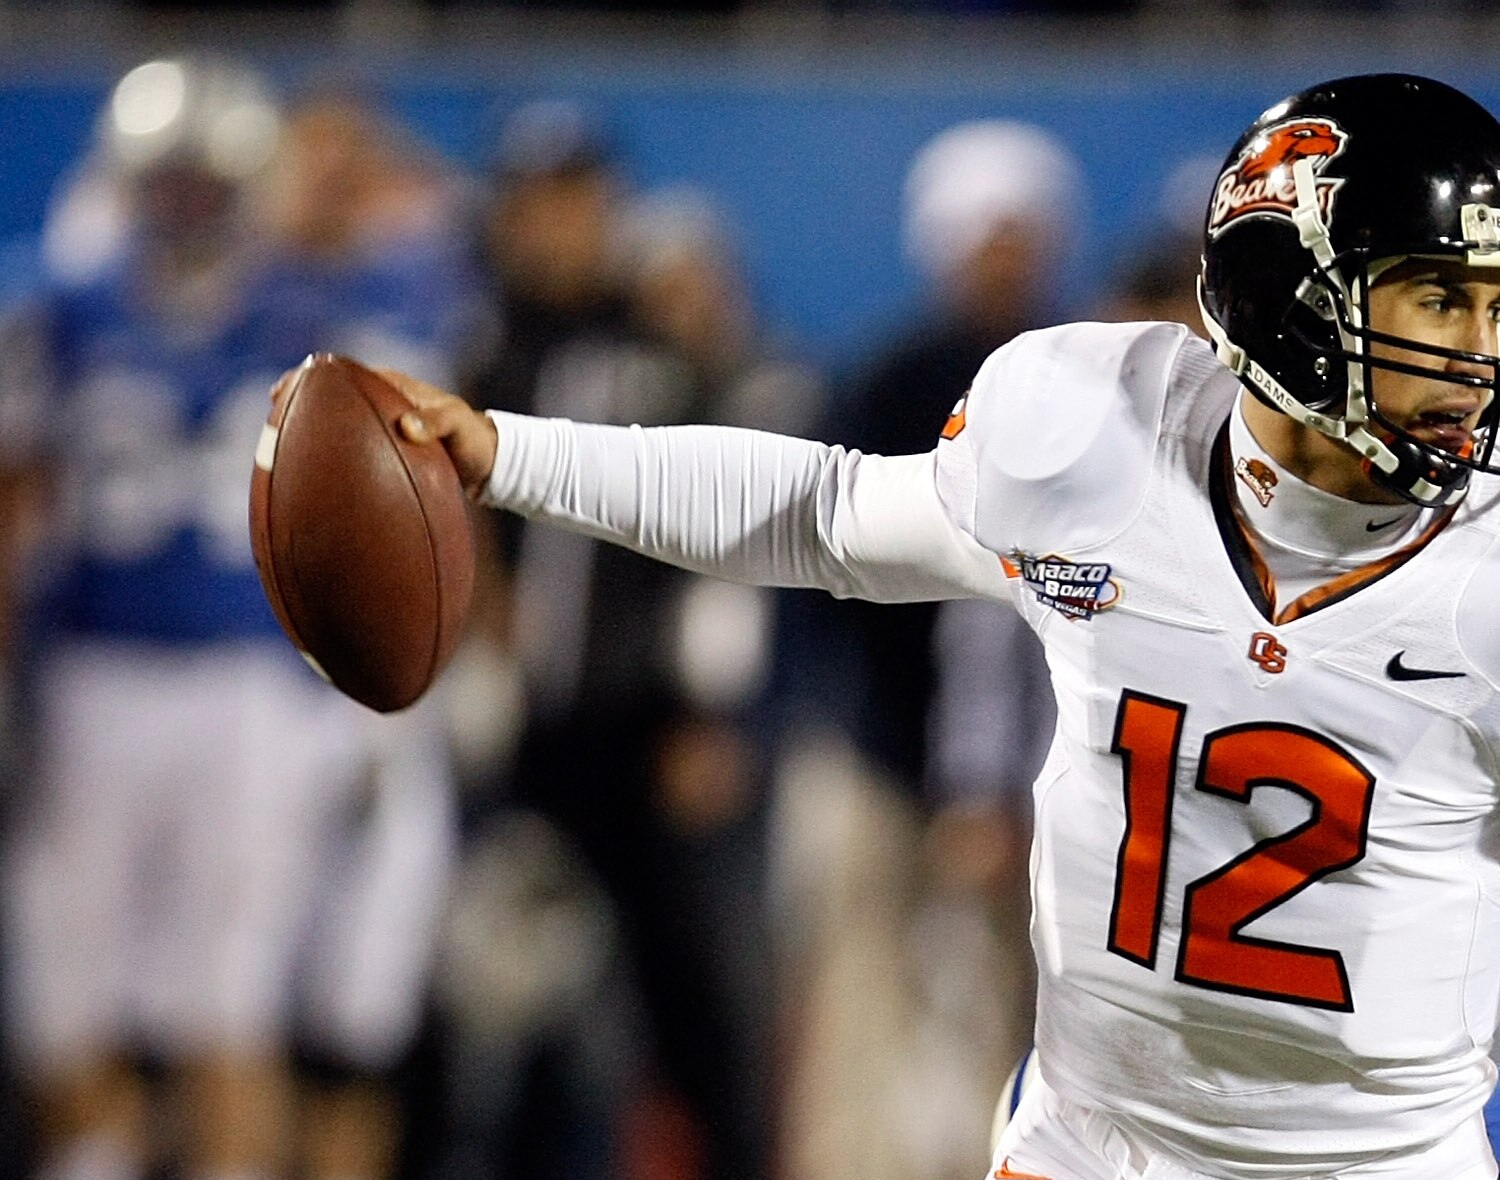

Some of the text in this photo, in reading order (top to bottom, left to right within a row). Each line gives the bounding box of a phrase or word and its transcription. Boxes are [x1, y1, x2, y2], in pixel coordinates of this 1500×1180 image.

[1211, 174, 1328, 225] Beave
[1243, 361, 1295, 409] ADAMS
[1106, 687, 1377, 1013] 12
